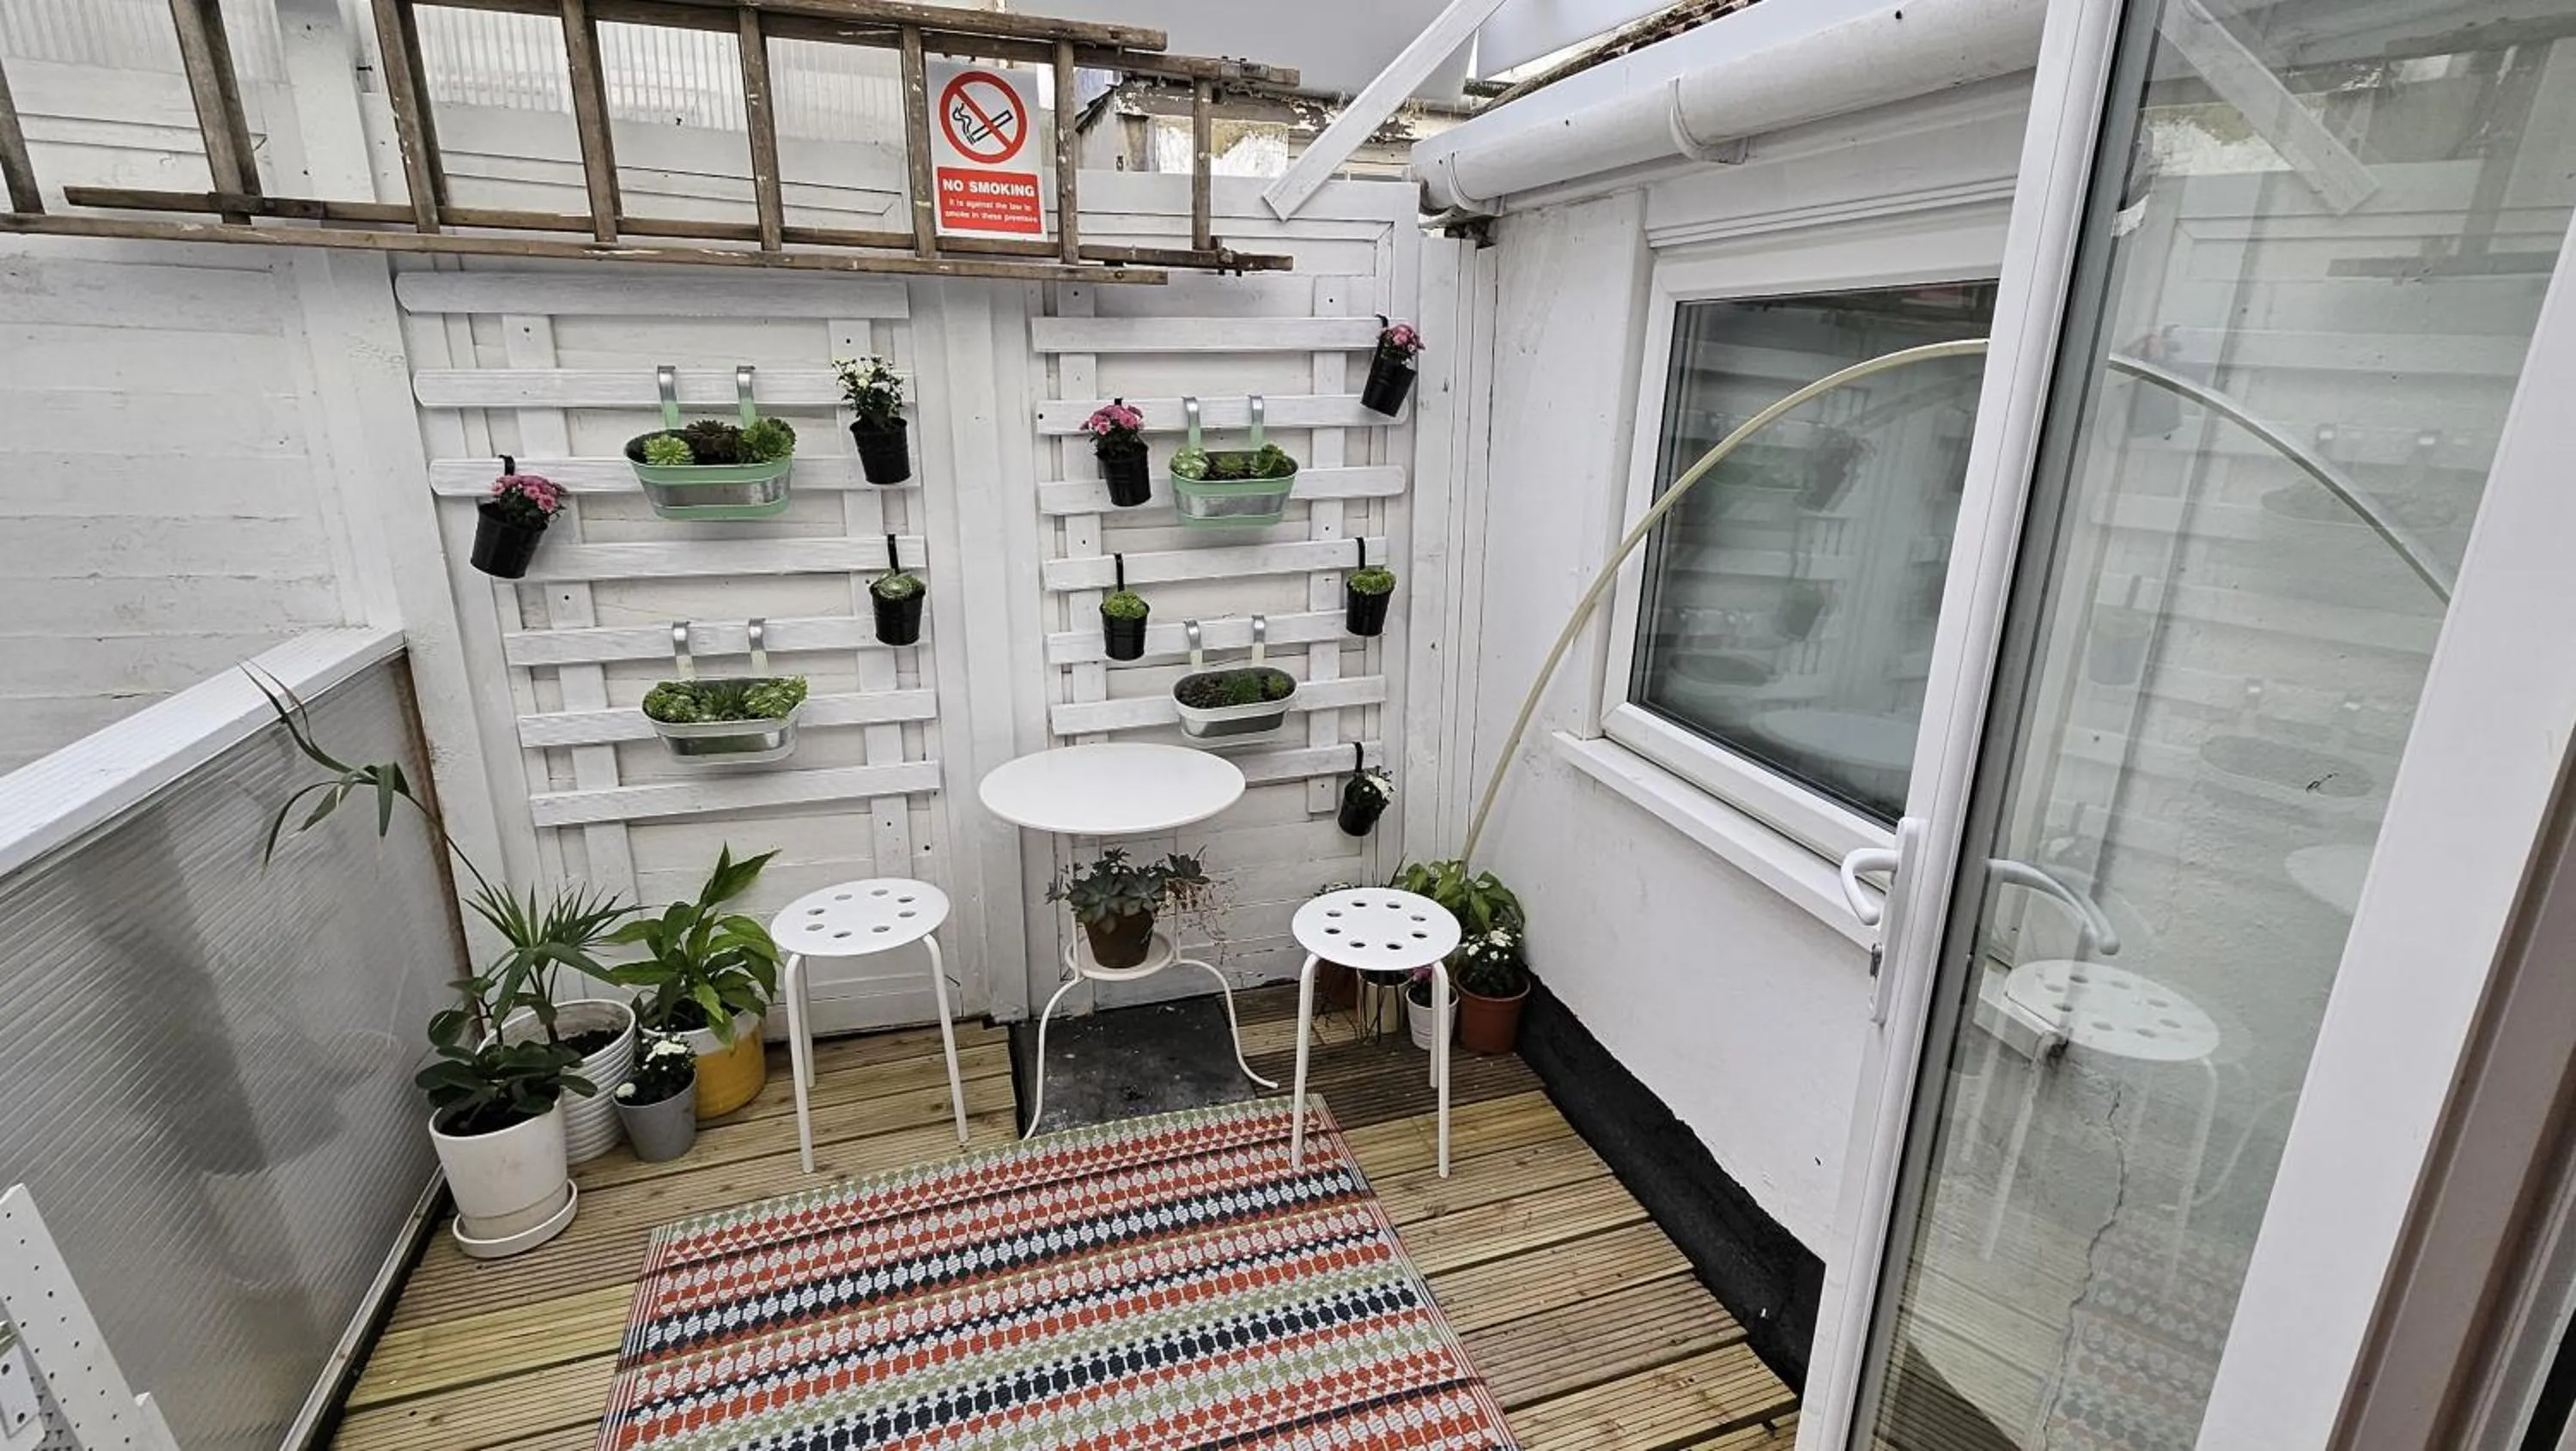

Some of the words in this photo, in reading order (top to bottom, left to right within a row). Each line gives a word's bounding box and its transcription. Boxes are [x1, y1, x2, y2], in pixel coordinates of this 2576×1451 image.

[943, 178, 963, 191] NO
[969, 180, 1035, 197] SMOKING
[966, 200, 993, 209] against
[1010, 202, 1022, 210] law
[981, 212, 1002, 221] these
